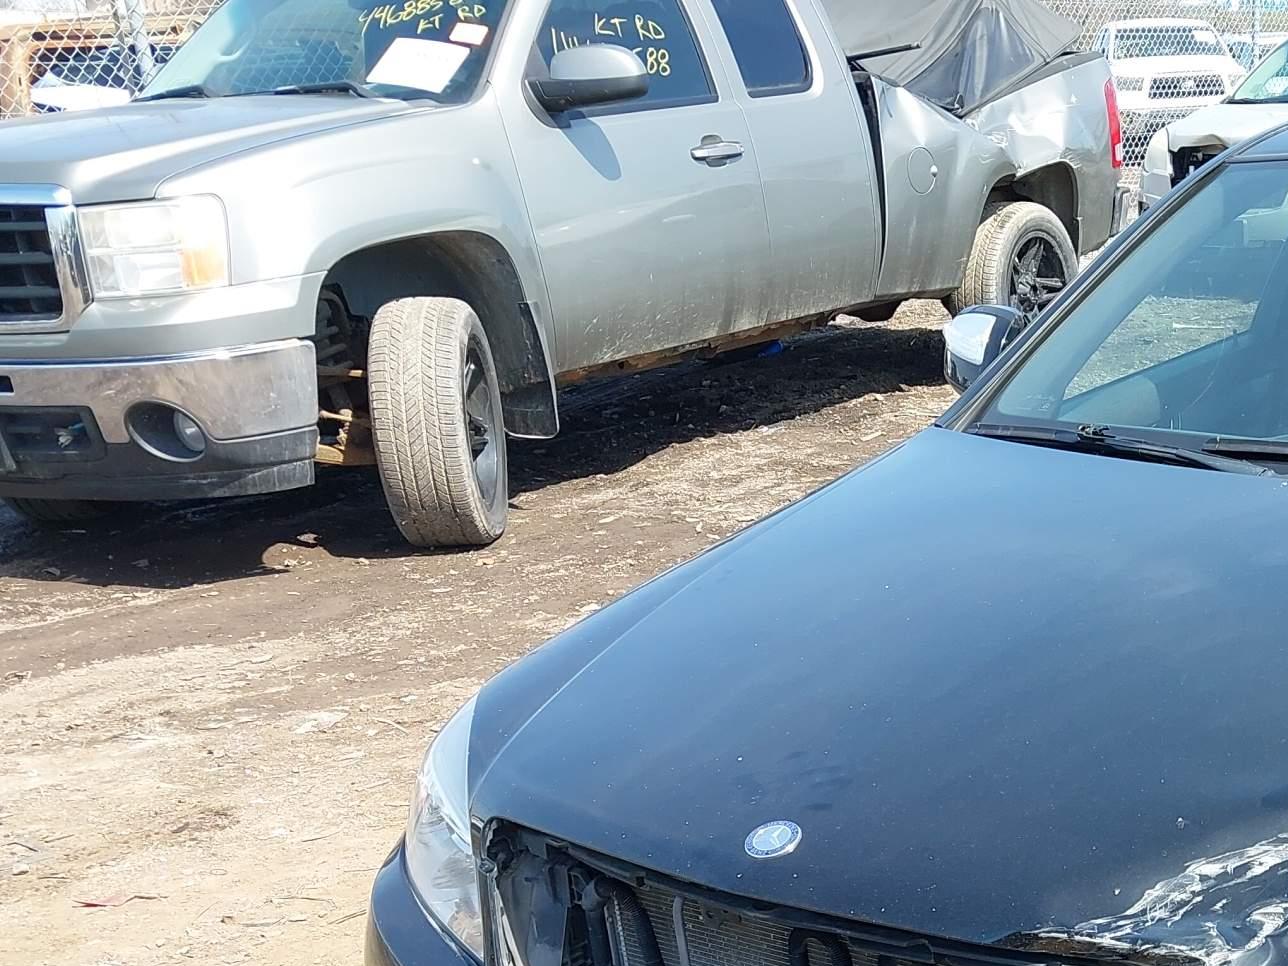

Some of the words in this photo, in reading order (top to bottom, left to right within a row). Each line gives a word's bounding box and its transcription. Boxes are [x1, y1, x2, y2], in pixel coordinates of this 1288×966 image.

[417, 14, 443, 35] KT
[458, 5, 487, 20] RD
[594, 13, 628, 37] KT
[635, 15, 665, 40] RD
